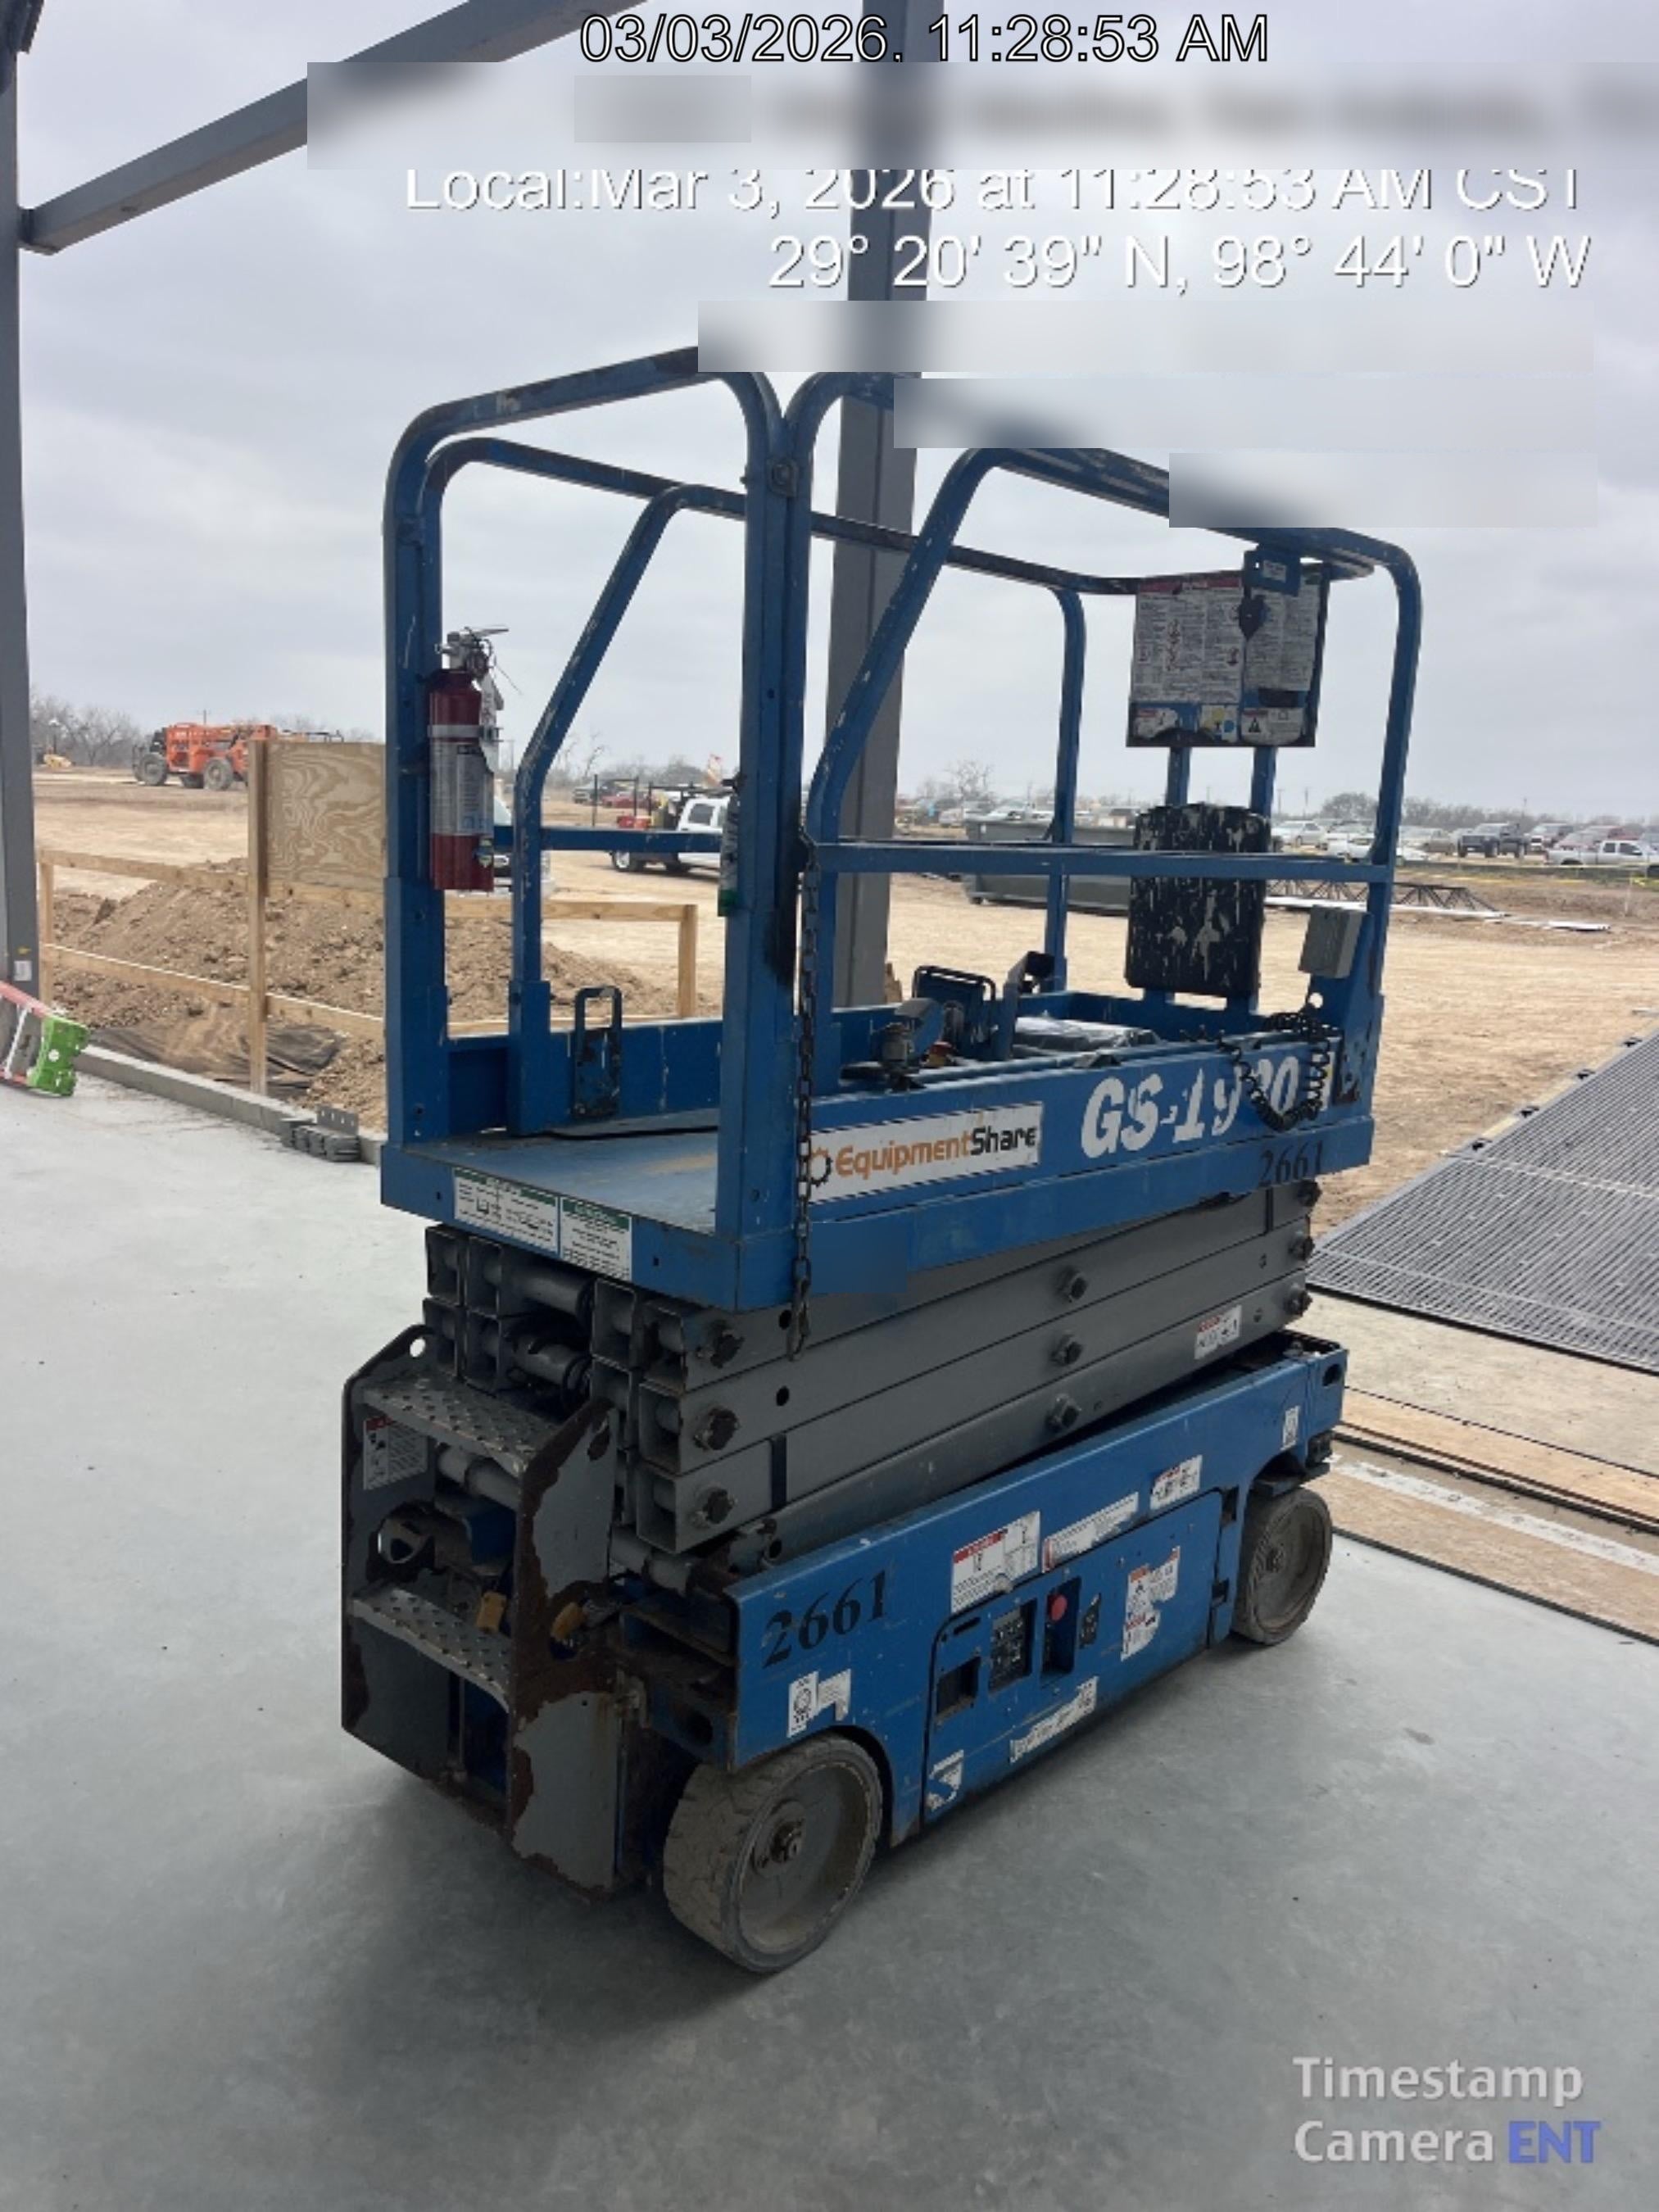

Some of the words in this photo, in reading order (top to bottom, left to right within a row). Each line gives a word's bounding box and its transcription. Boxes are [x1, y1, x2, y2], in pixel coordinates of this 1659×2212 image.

[835, 1125, 1037, 1181] EquipmentShare
[1258, 1139, 1323, 1188] 2661
[761, 1569, 886, 1669] 2661
